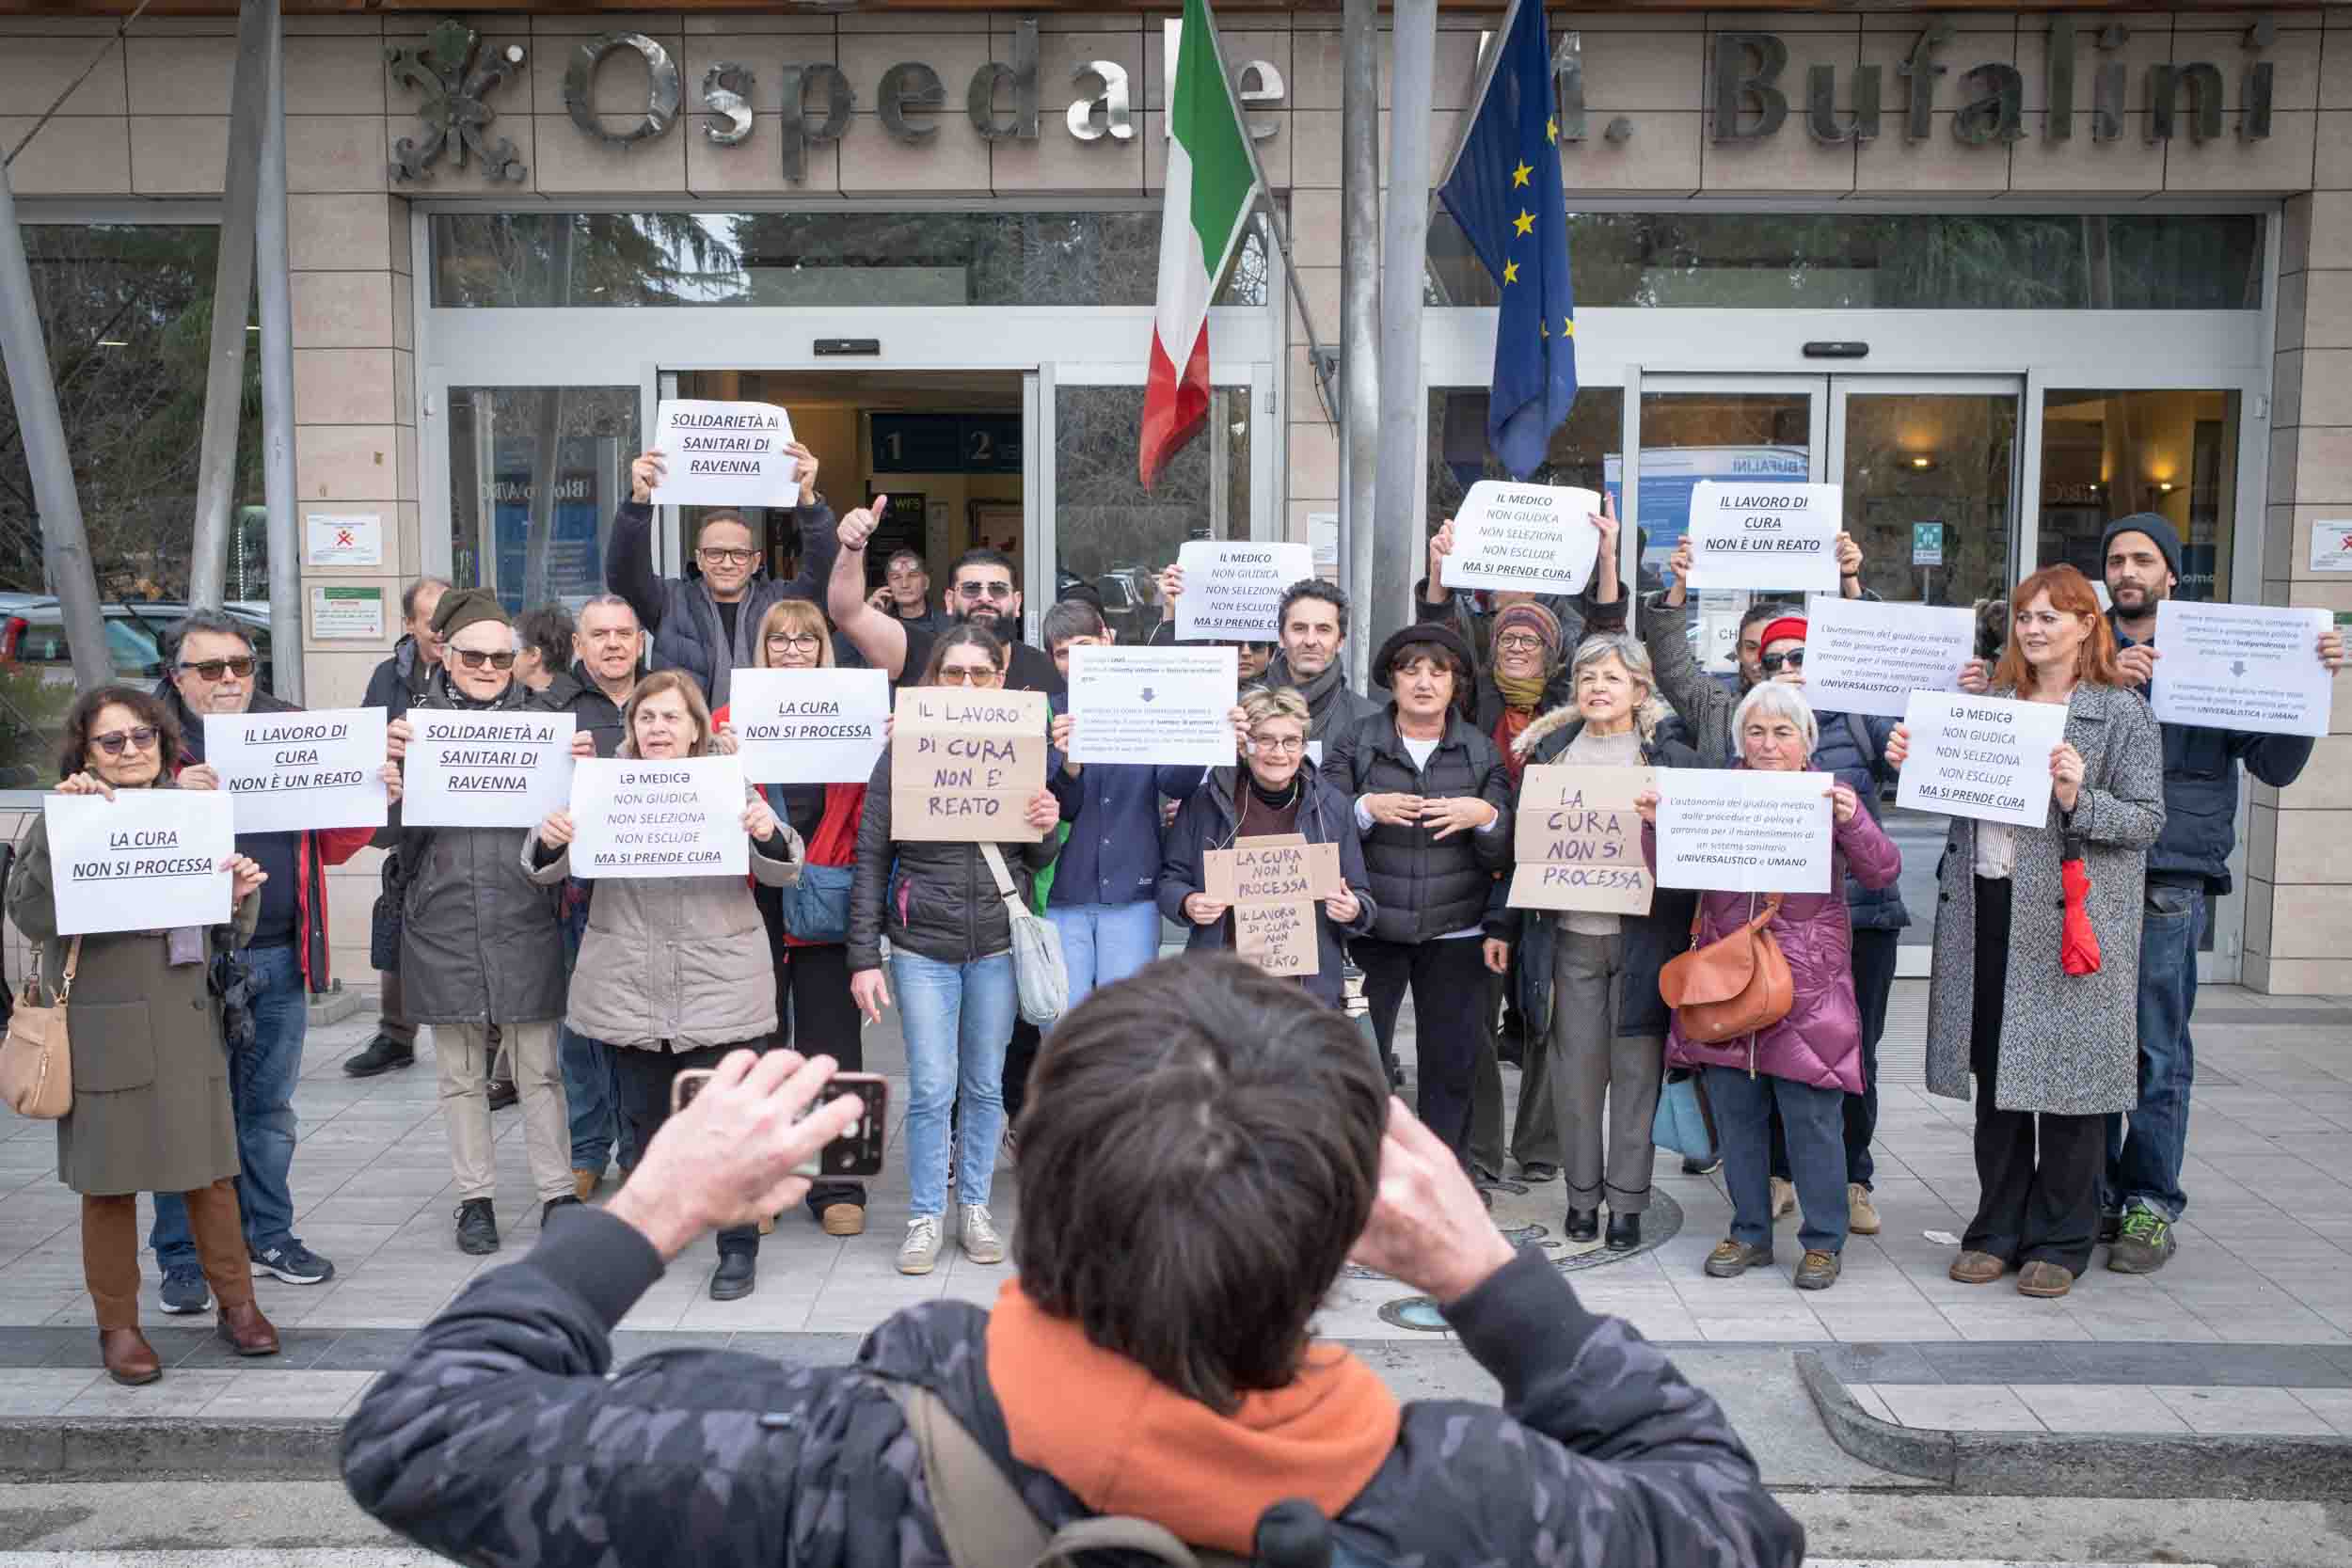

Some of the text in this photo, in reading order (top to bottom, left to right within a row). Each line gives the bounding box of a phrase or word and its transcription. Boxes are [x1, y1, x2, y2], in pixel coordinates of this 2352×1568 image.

[1714, 14, 2274, 143] Bufalini
[671, 414, 778, 428] SOLIDARIETÀ AI
[683, 437, 769, 451] SANITARI DI
[887, 431, 903, 460] 1
[970, 430, 993, 460] 2
[691, 460, 760, 473] RAVENNA
[1498, 494, 1552, 506] IL MEDICO
[1720, 496, 1807, 508] IL LAVORO DI
[1487, 510, 1559, 523] NON GIUDICA
[1745, 517, 1781, 529] CURA
[1480, 527, 1563, 542] NON SELEZIONA
[1706, 536, 1820, 551] NON È UN REATO
[1220, 554, 1271, 563] IL MEDICO
[1483, 545, 1557, 559] NON ESCLUDE
[1212, 569, 1279, 578] NON GIUDICA
[1463, 562, 1571, 579] MA SI PRENDE CURA
[1206, 586, 1229, 594] NON
[1211, 602, 1232, 610] NON
[1194, 617, 1279, 628] MA SI PRENDE CU
[1820, 678, 1899, 692] UNIVERSALISTICO
[779, 702, 838, 714] LA CURA
[919, 702, 1018, 722] IL LAVORO
[245, 724, 346, 742] IL LAVORO DI
[427, 724, 555, 740] SOLIDARIETÀ AI
[746, 725, 871, 737] NON SI PROCESSA
[1943, 727, 2015, 745] NON GIUDICA
[276, 750, 318, 764] CURA
[440, 751, 538, 765] SANITARI DI
[948, 739, 1016, 763] CURA
[1936, 746, 2020, 766] NON SELEZIONA
[229, 771, 362, 790] NON È UN REATO
[449, 776, 526, 790] RAVENNA
[934, 768, 971, 787] NON
[1939, 768, 2013, 785] NON ESCLUDE
[613, 793, 698, 804] NON GIUDICA
[1561, 787, 1582, 808] LA
[1919, 784, 2025, 808] MA SI PRENDE CURA
[930, 797, 1000, 816] REATO
[608, 812, 706, 824] NON SELEZIONA
[1548, 812, 1621, 835] CURA
[110, 831, 178, 847] LA CURA
[615, 832, 699, 843] NON ESCLUDE
[595, 851, 722, 863] MA SI PRENDE CURA
[1548, 840, 1595, 860] NON
[1237, 850, 1302, 865] LA CURA
[1677, 854, 1756, 864] UNIVERSALISTICO
[1768, 858, 1806, 866] UMANO
[73, 858, 212, 878] NON SI PROCESSA
[1252, 865, 1297, 879] NON SI
[1544, 867, 1641, 889] PROCESSA
[1239, 879, 1308, 896] PROCESSA
[1252, 909, 1296, 920] LAVORO
[1264, 920, 1300, 932] CURA
